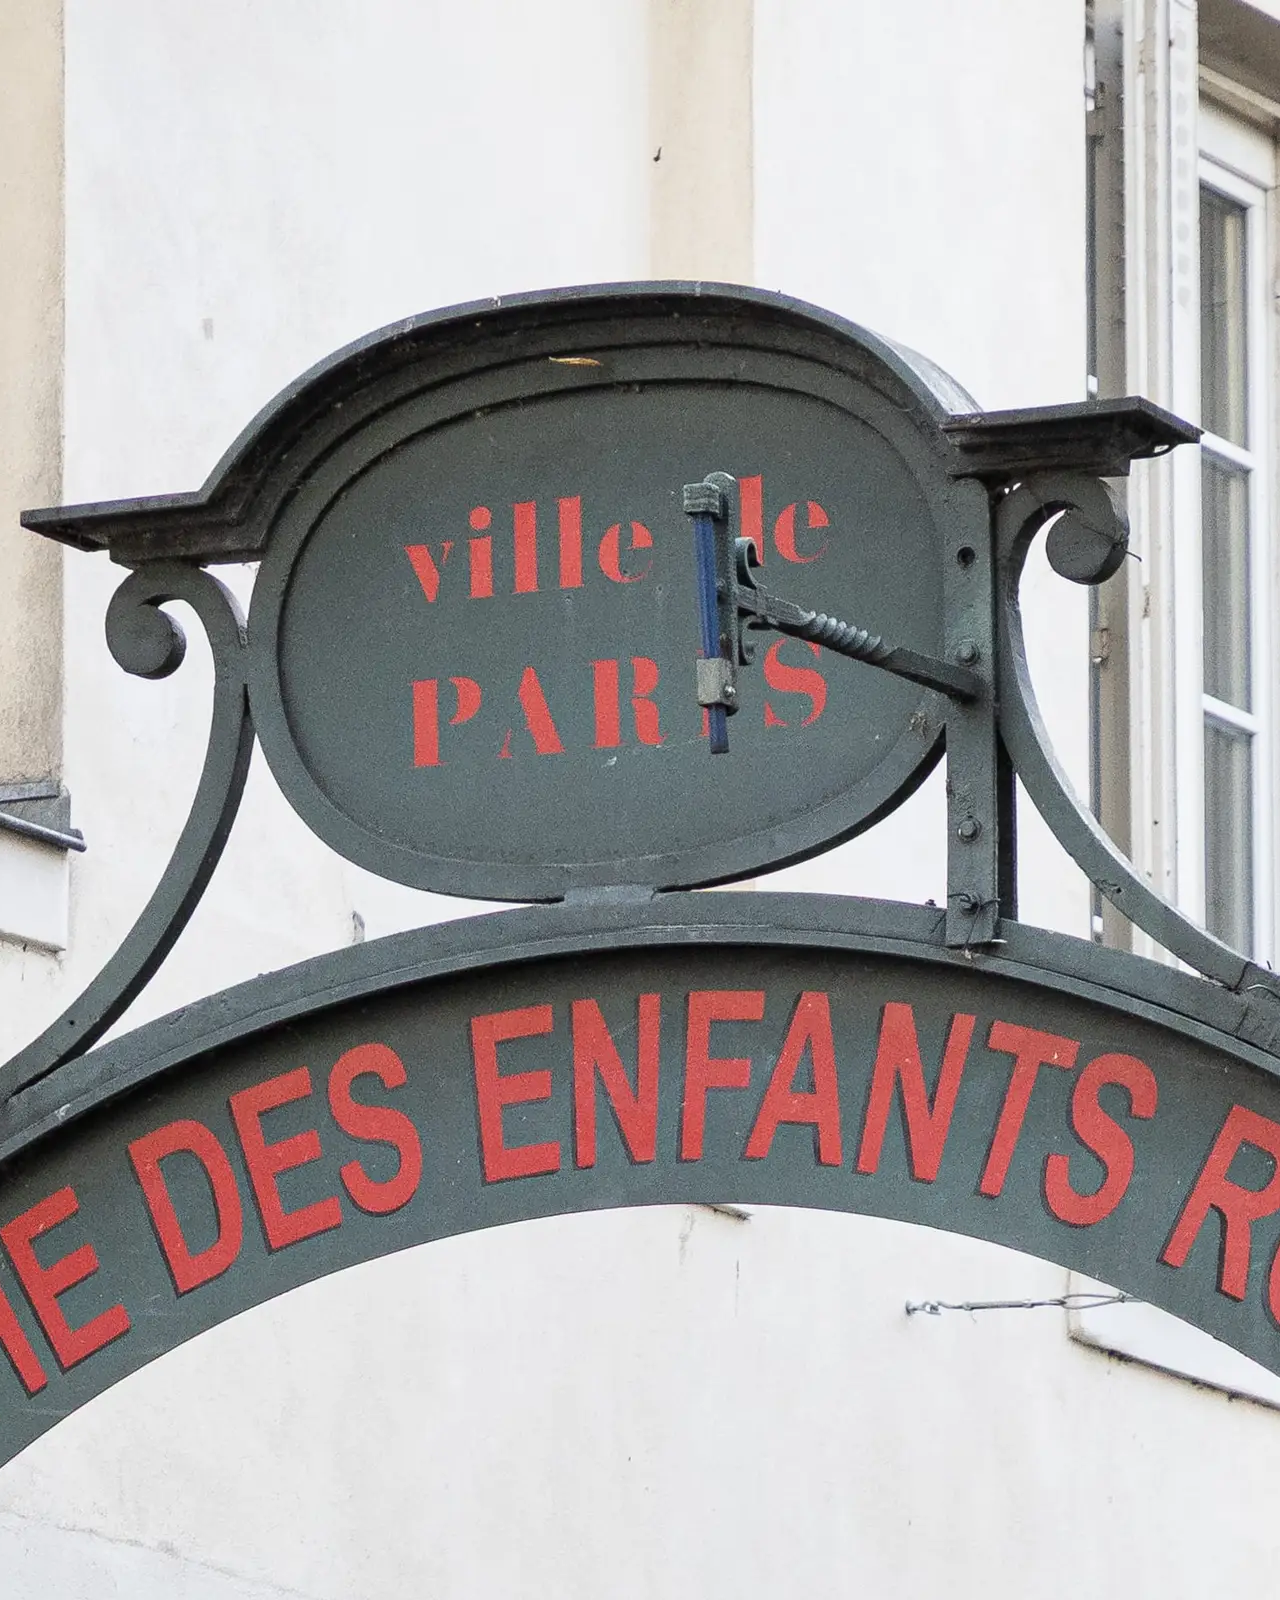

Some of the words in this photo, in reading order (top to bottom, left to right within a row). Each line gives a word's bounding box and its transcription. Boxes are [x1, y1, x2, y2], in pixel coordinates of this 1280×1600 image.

[404, 496, 653, 603] ville
[410, 637, 827, 768] PARS
[128, 1043, 422, 1296] DES
[470, 991, 1158, 1228] ENFANTS
